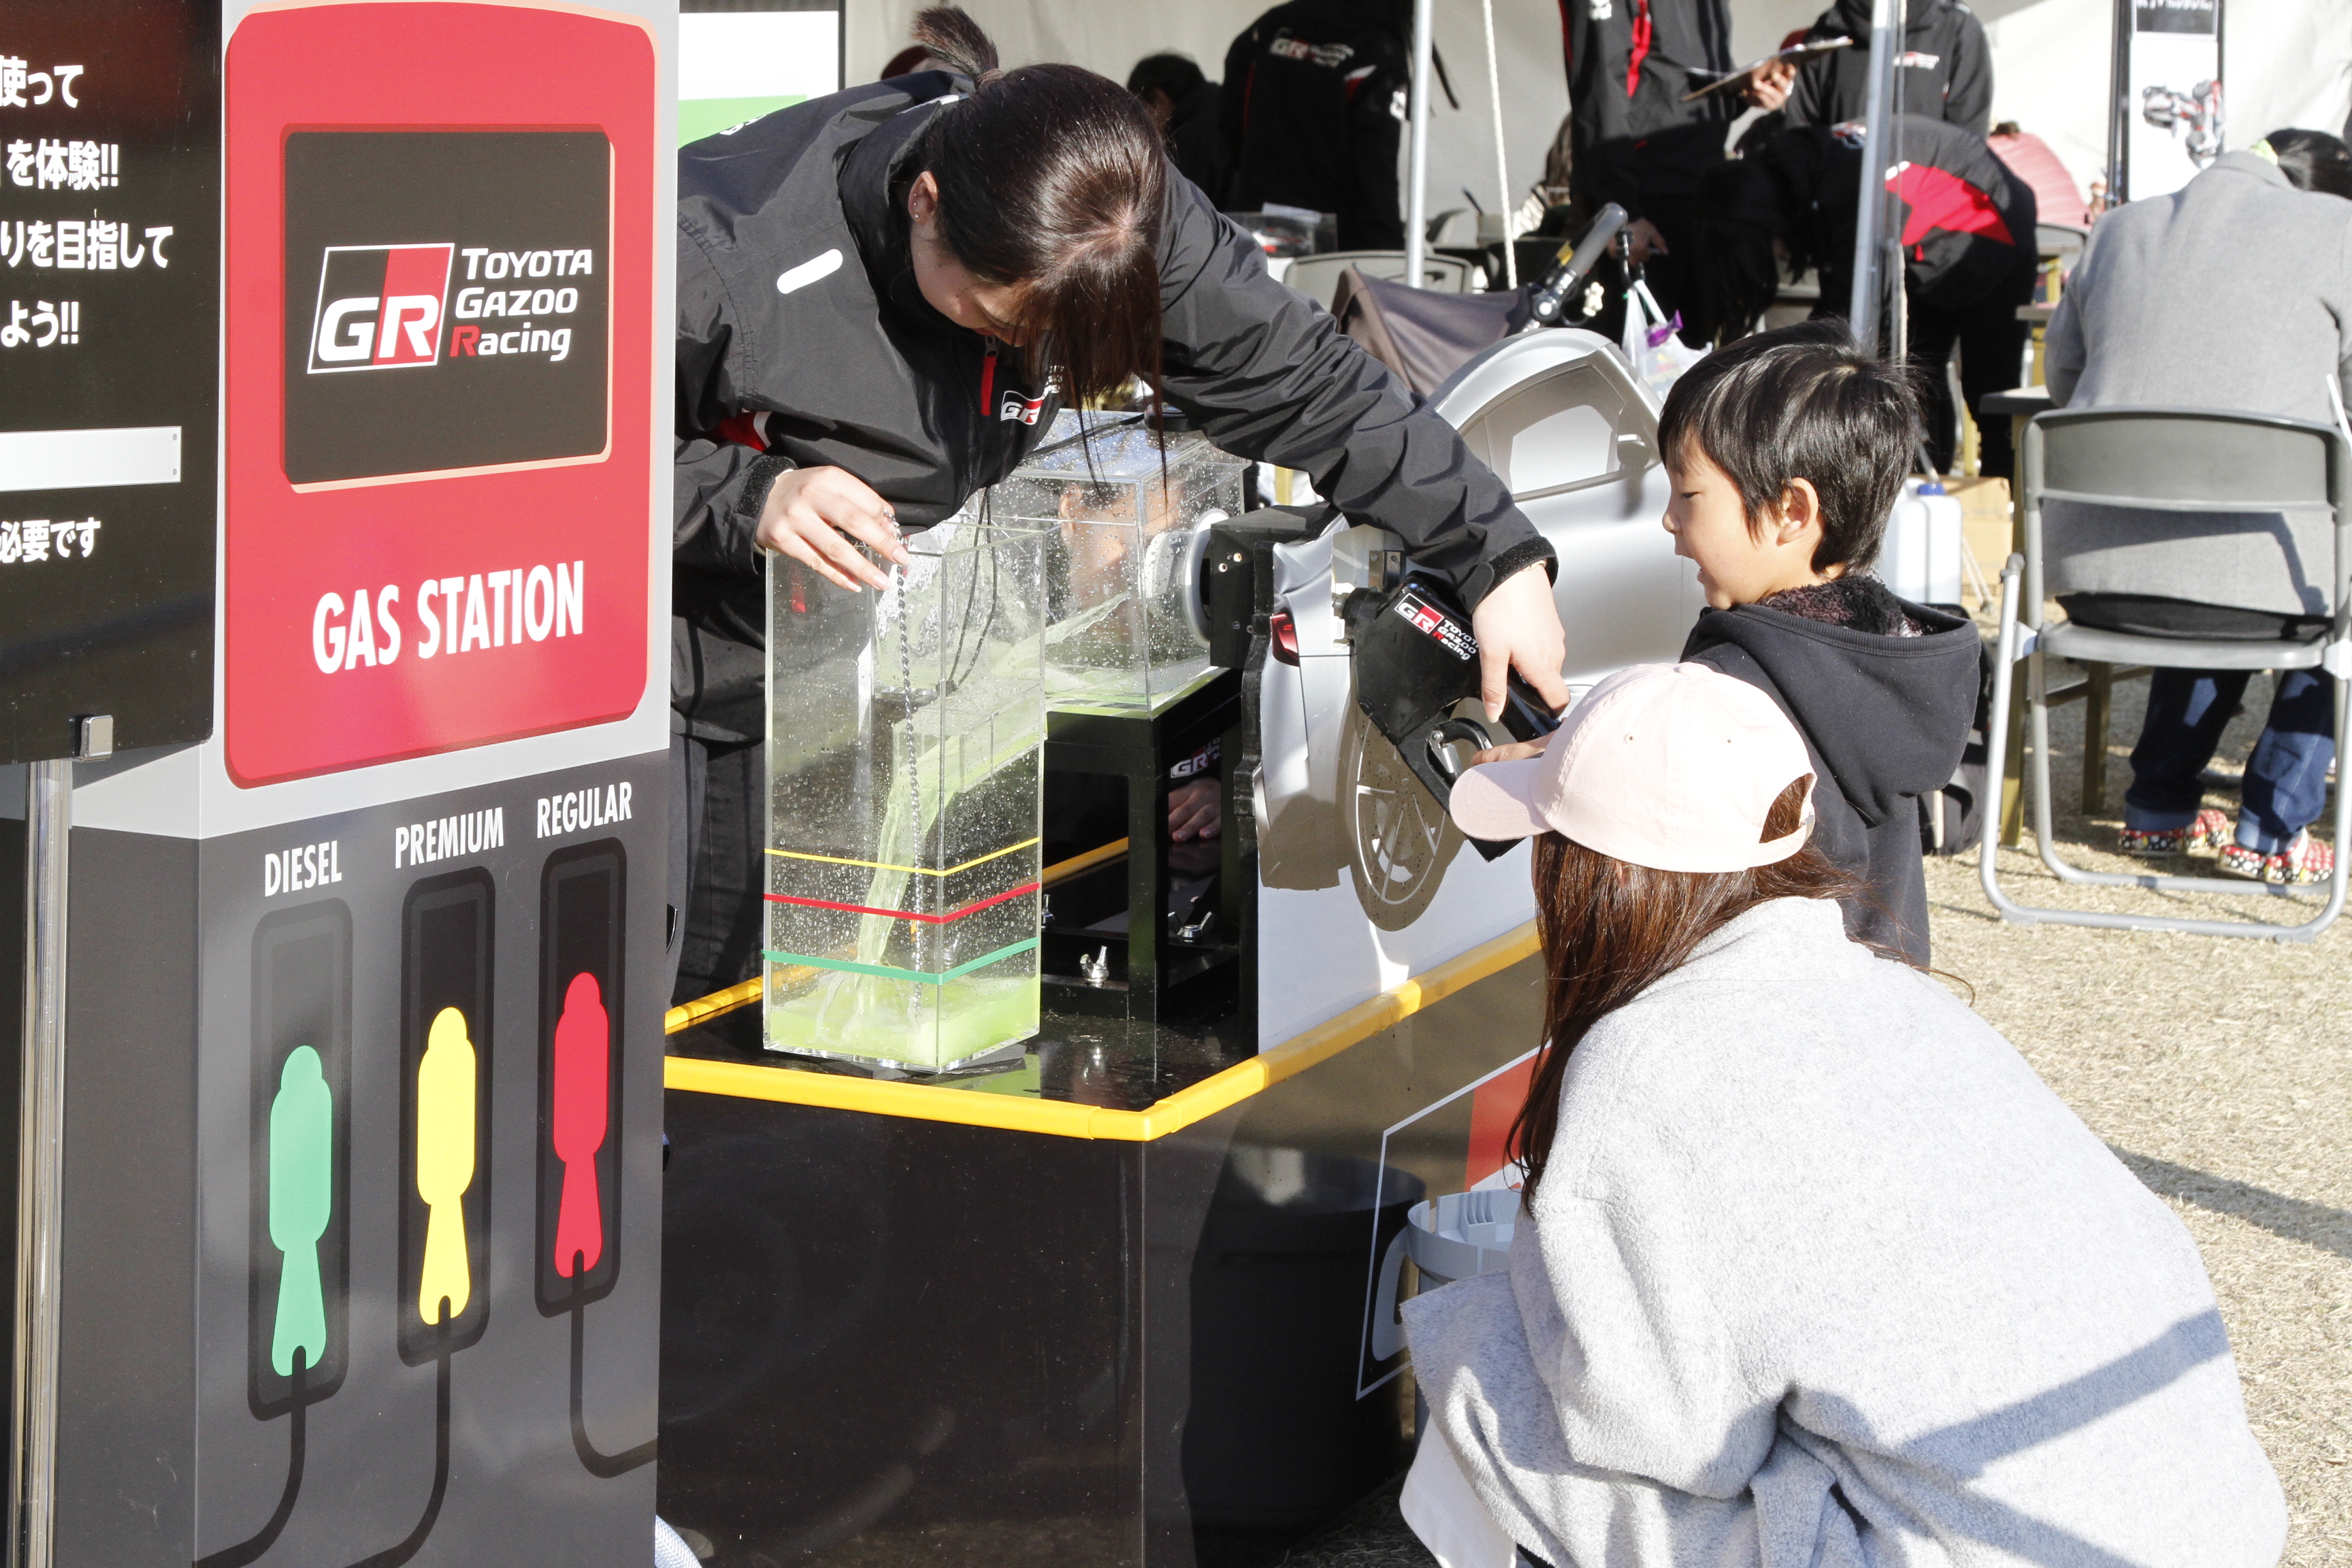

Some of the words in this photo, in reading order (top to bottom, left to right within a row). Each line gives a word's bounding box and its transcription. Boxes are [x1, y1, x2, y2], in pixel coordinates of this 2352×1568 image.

[0, 56, 84, 108] 使って
[7, 139, 118, 191] を体験!!
[1, 220, 174, 270] りを目指して
[461, 248, 593, 280] TOYOTA
[1, 301, 79, 348] よう!!
[455, 287, 578, 319] GAZOO
[317, 294, 440, 362] GR
[450, 321, 572, 363] Racing
[0, 517, 101, 564] 必要です
[312, 584, 402, 674] GAS
[416, 560, 584, 660] STATION
[1397, 602, 1436, 632] GR
[1437, 625, 1477, 654] GAZOO
[1443, 619, 1479, 648] TOYOT
[1432, 630, 1471, 660] Racing
[536, 781, 633, 839] REGULAR
[395, 806, 505, 870] PREMIUM
[264, 840, 343, 898] DIESEL
